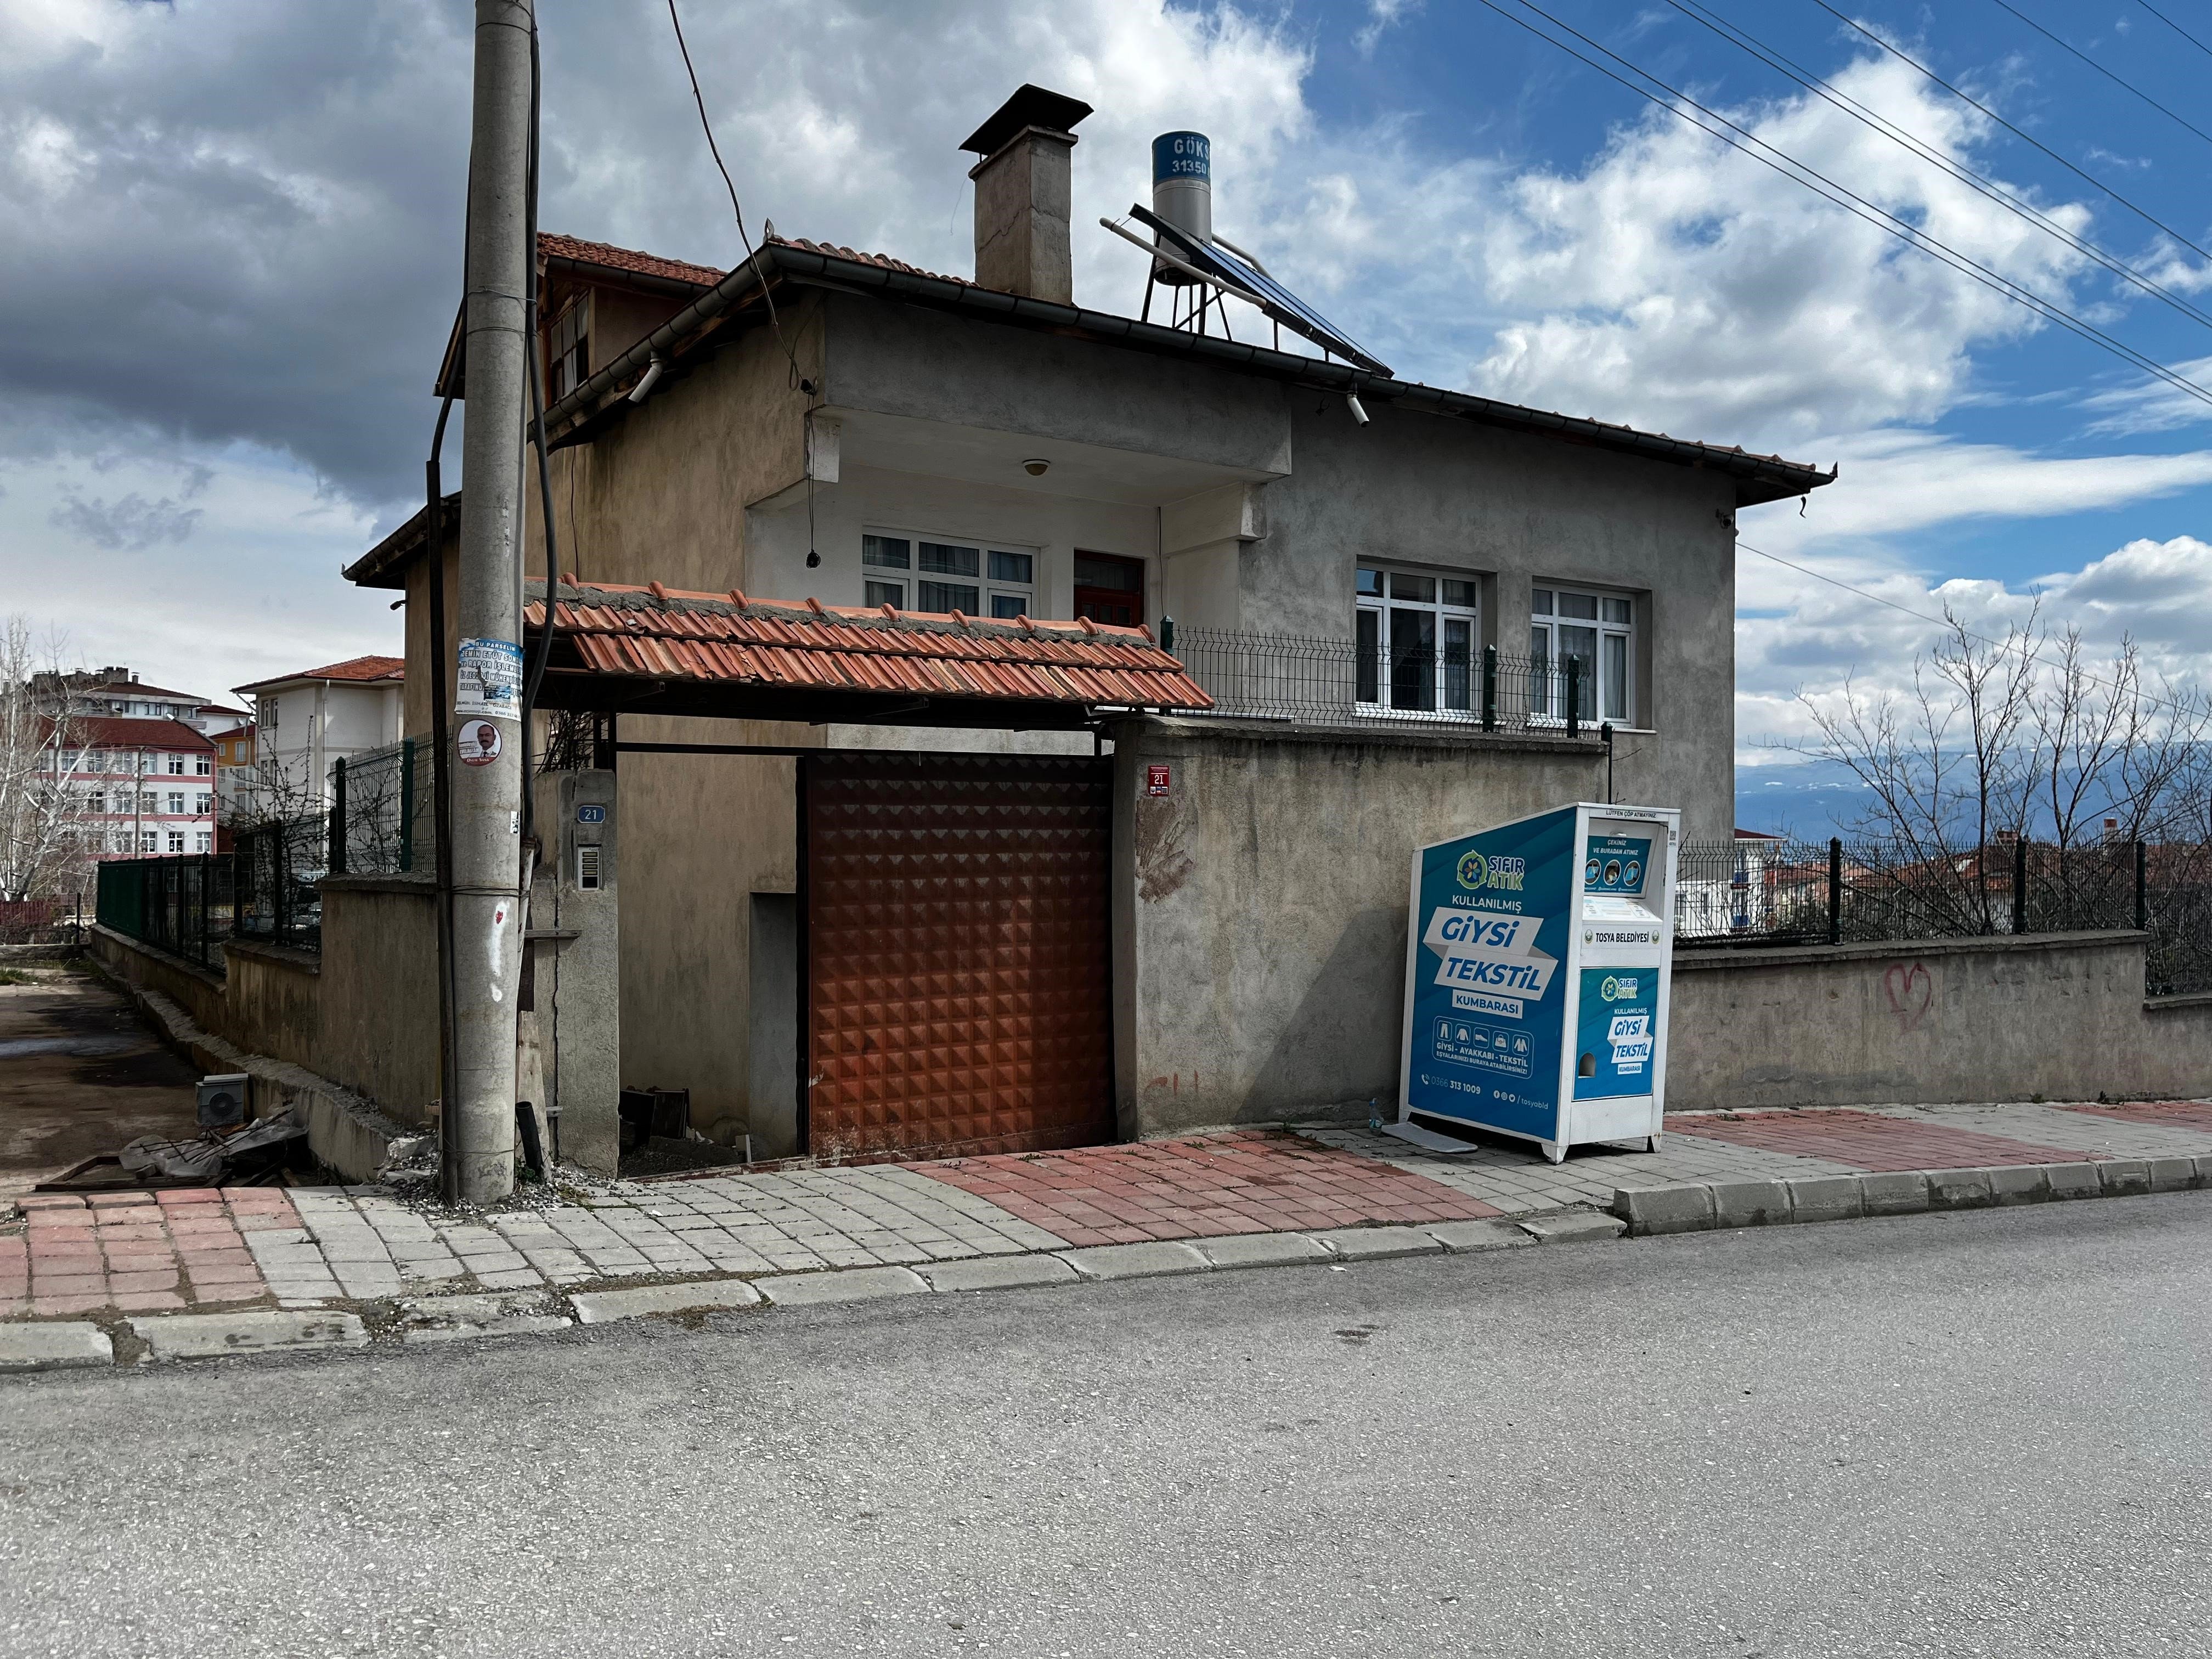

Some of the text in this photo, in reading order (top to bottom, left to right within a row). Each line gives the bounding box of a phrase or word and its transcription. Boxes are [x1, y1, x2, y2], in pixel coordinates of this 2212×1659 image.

[486, 642, 516, 652] PARSELİN
[483, 650, 503, 659] ETÜT
[468, 660, 492, 668] RAPOR
[1155, 775, 1163, 785] 21
[585, 809, 597, 820] 21
[1488, 856, 1525, 873] SIFIR
[1487, 871, 1523, 890] ATIK
[1452, 895, 1521, 913] KULLANILMIŞ
[1596, 931, 1649, 943] TOSYA BELEDİYESİ
[1618, 978, 1637, 988] SIFIR
[1618, 988, 1637, 998] ATIK
[1456, 995, 1519, 1014] KUMBARASI
[1437, 1041, 1454, 1052] GİYSİ
[1460, 1047, 1494, 1060] AYAKKABI
[1499, 1054, 1528, 1067] TEKSTİL
[1437, 1051, 1469, 1062] EŞYALARINIZI
[1469, 1058, 1489, 1066] BURAYA
[1431, 1076, 1481, 1094] 0366 313 1009
[1521, 1098, 1549, 1109] tosyabld
